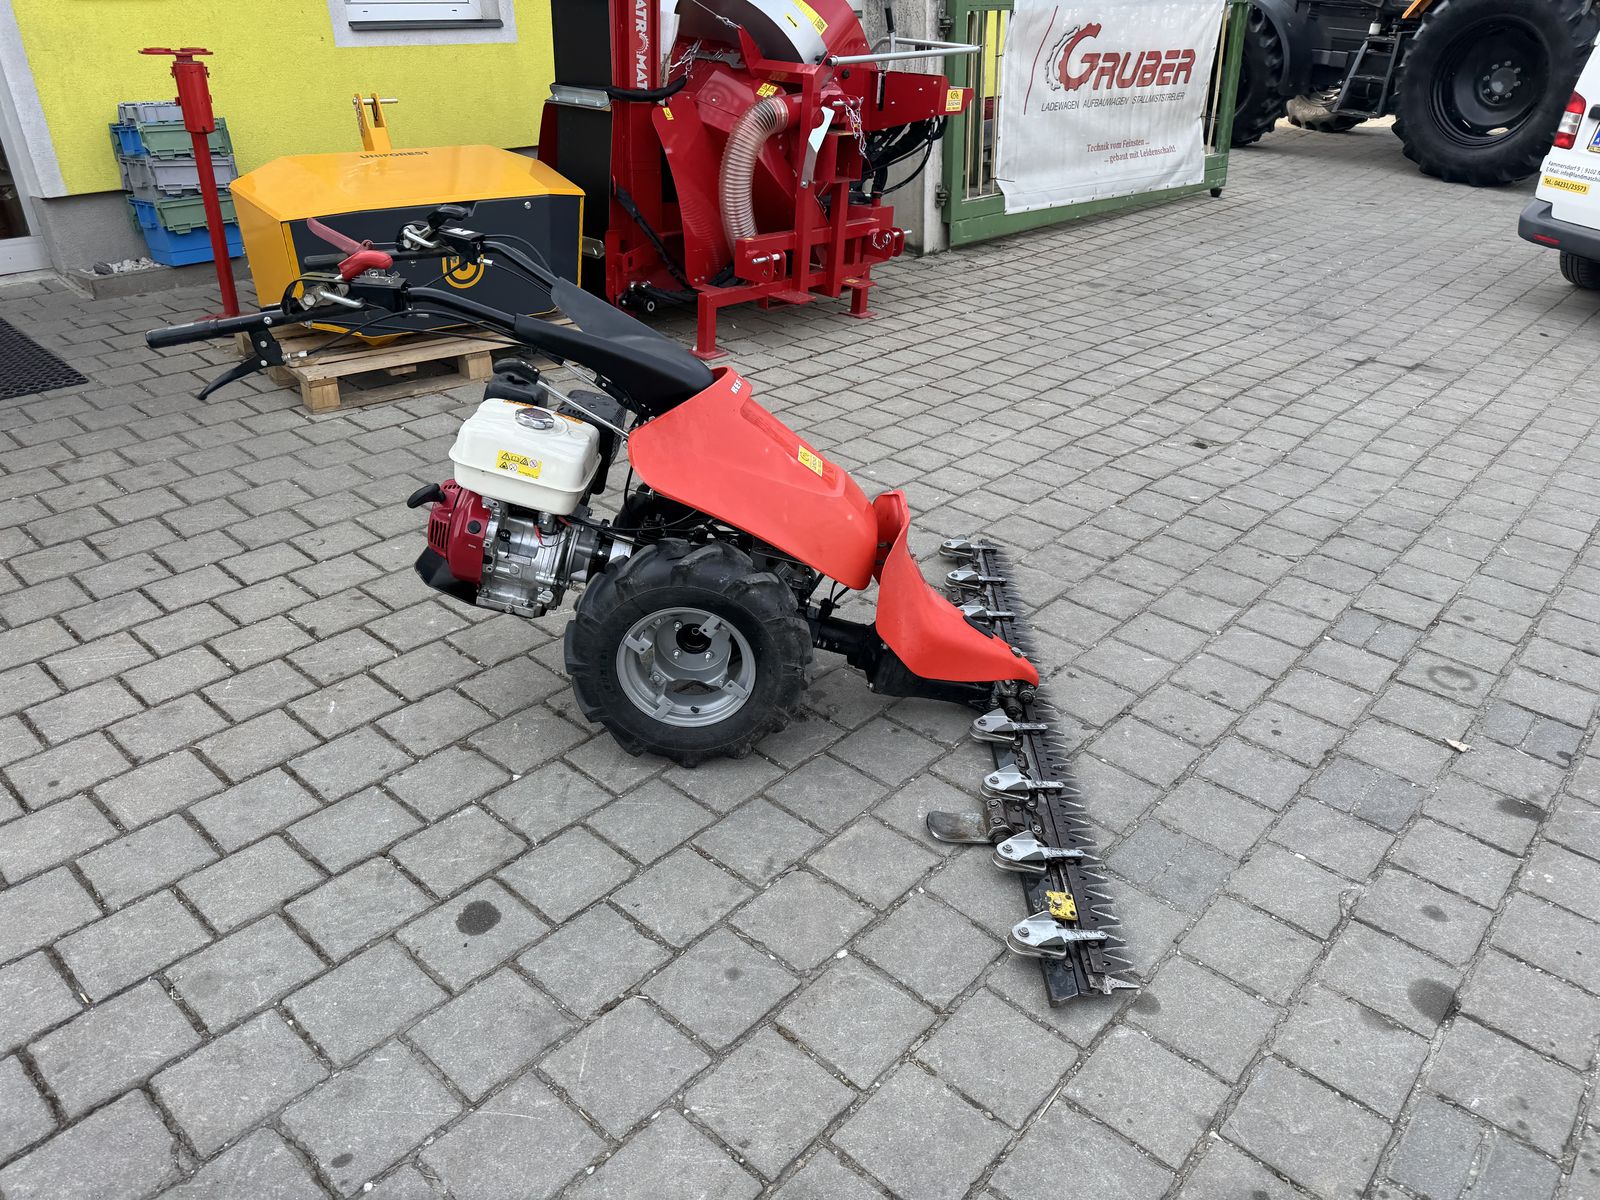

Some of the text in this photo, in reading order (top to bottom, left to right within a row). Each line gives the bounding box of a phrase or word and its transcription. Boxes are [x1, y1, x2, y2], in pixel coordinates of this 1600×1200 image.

[1058, 22, 1196, 92] GRUBER
[1041, 99, 1080, 112] LADEWAGEN
[1083, 96, 1129, 109] AUFBAUWAGEN
[1087, 141, 1110, 152] Technik
[1122, 139, 1145, 149] Feinsten
[1109, 153, 1128, 164] gebaut
[1129, 151, 1140, 159] mit
